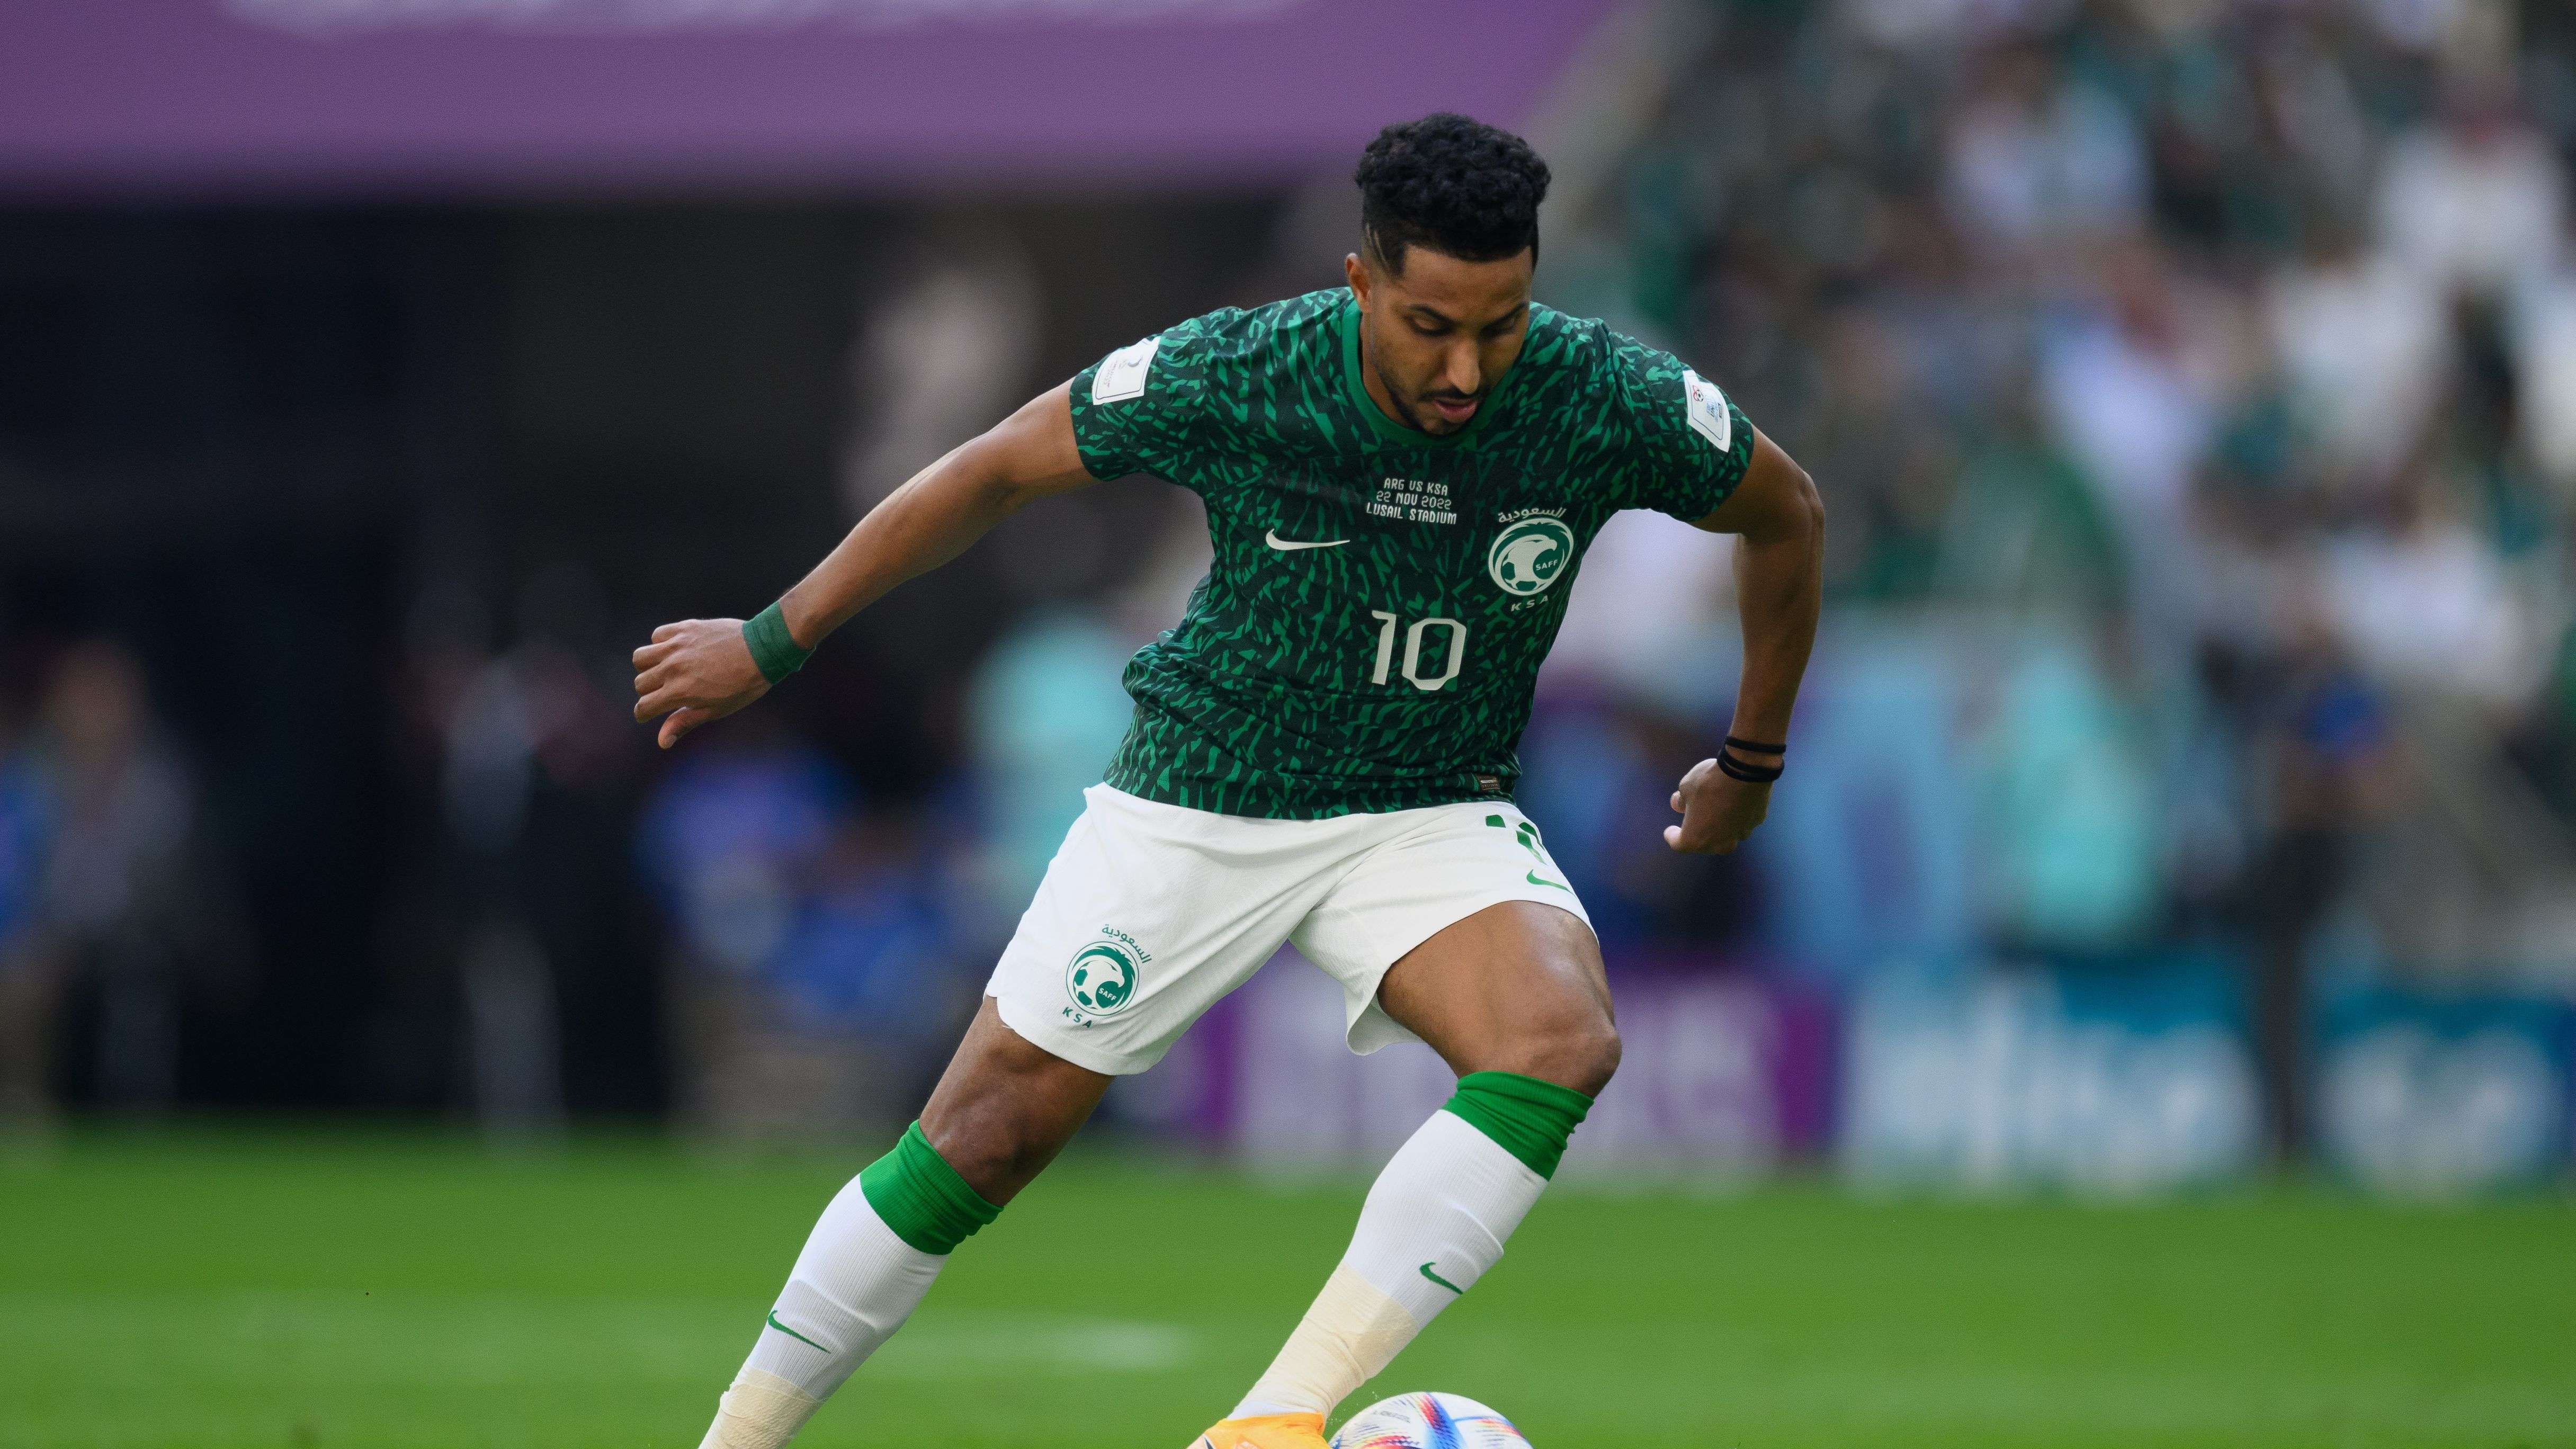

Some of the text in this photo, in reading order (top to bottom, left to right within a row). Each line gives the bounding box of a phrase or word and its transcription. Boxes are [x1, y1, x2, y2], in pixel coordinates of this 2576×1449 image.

[1383, 478, 1405, 490] ARG
[1427, 482, 1448, 496] KSA
[1376, 490, 1452, 510] 22 NOV 2022
[1366, 502, 1457, 525] LUSAIL STADIUM
[1498, 507, 1566, 523] السعودية
[1536, 559, 1558, 571] SAFF
[1510, 595, 1549, 612] KSA
[1372, 610, 1467, 691] 10
[1102, 924, 1152, 964] السعودية
[1098, 988, 1117, 1001] SAFF
[1062, 1006, 1092, 1028] KSA
